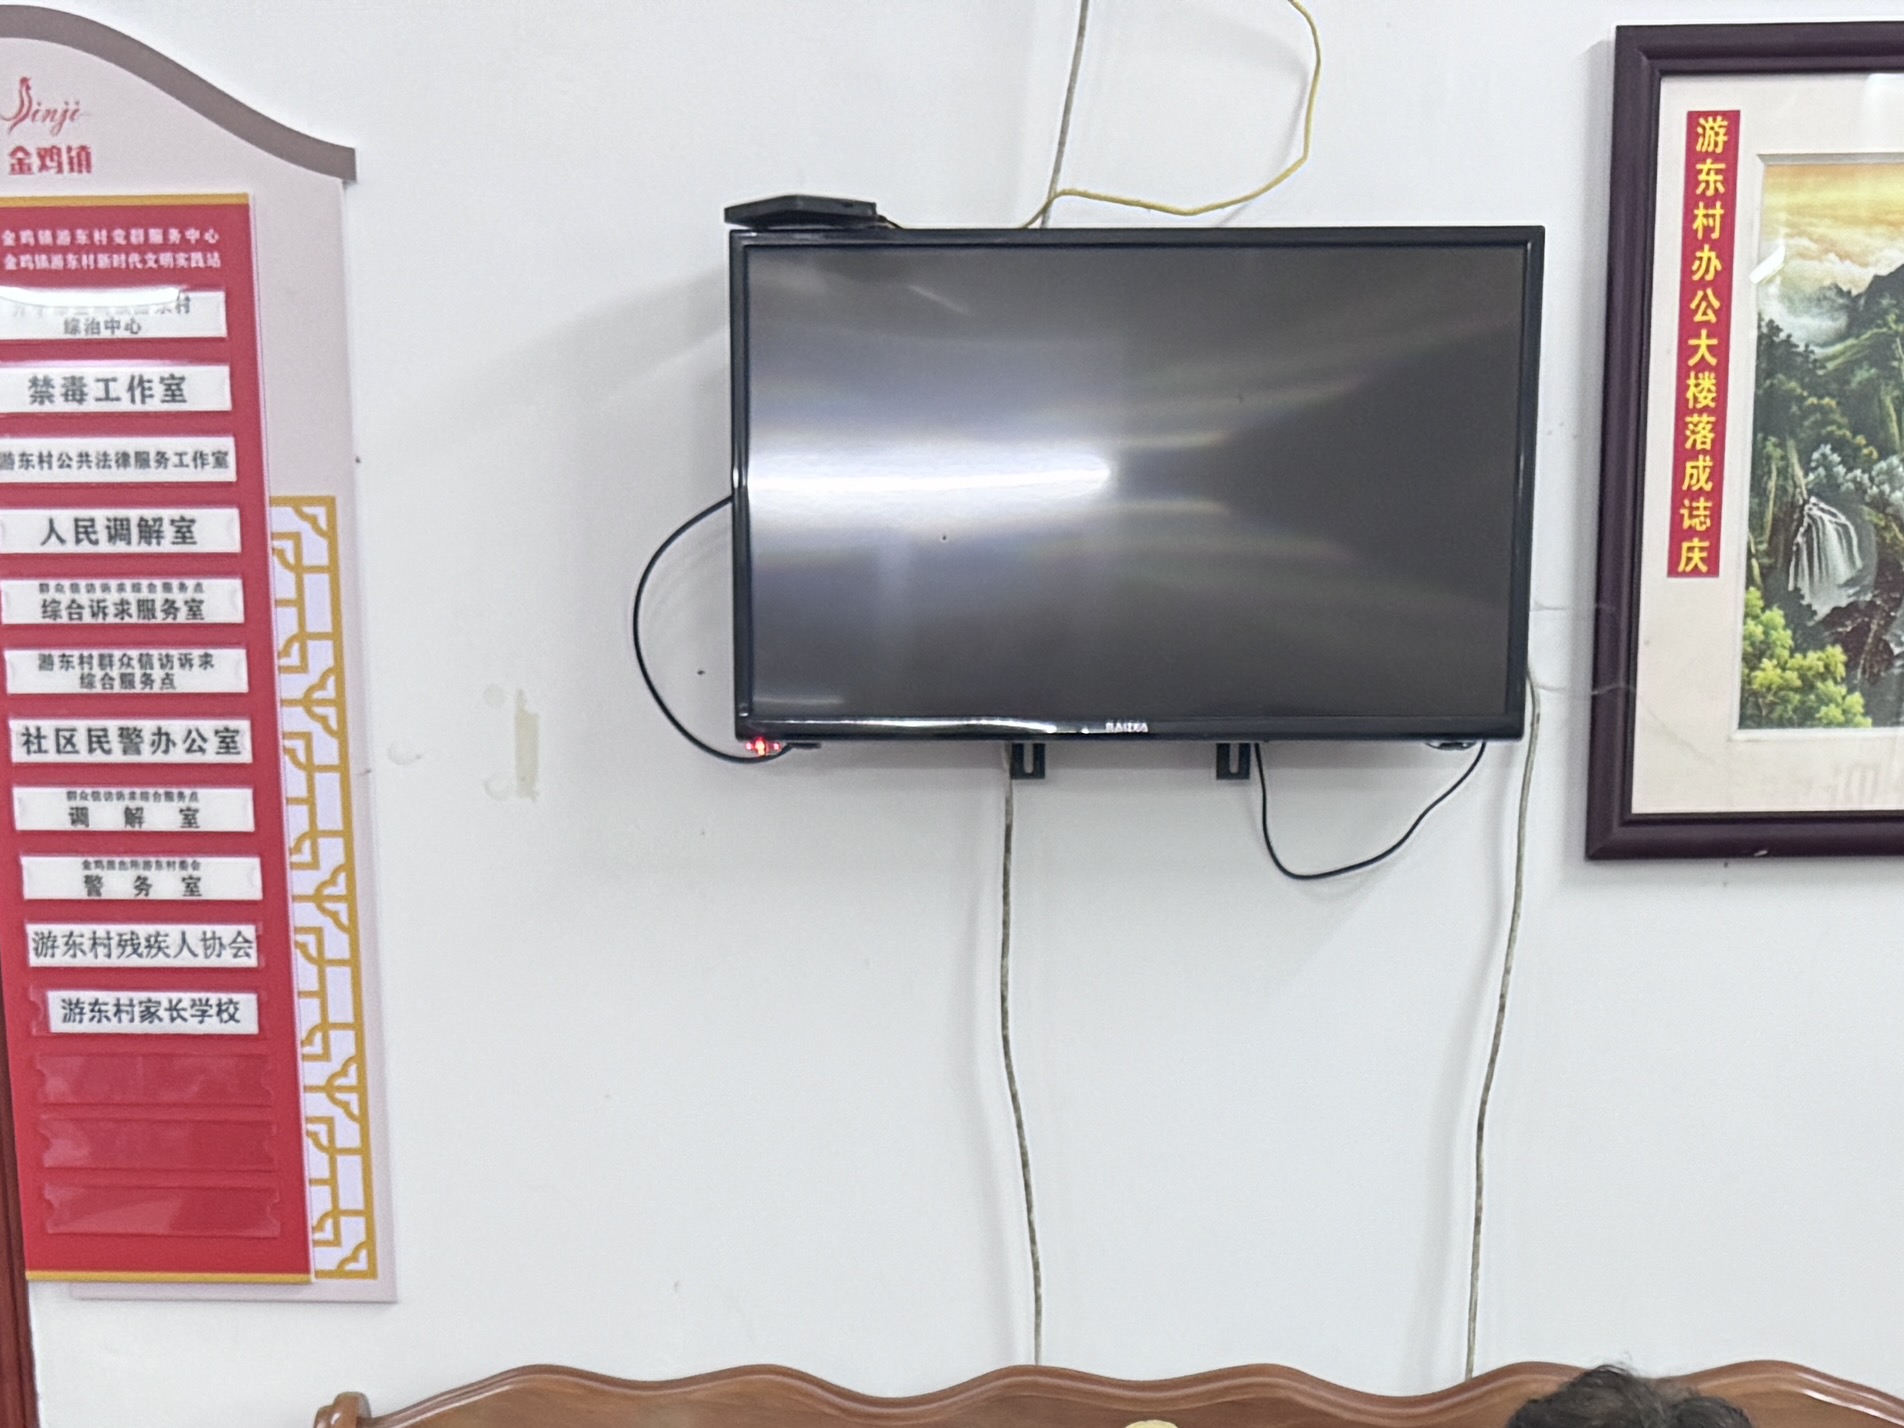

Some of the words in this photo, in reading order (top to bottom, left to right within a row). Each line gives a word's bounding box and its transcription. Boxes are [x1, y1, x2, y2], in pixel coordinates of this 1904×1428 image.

[7, 144, 93, 176] 金鸡镇
[27, 373, 188, 406] 禁毒工作室
[40, 515, 198, 547] 人民调解室
[41, 597, 206, 622] 综合诉求服务室
[38, 652, 215, 671] 游东村群众信访诉求
[79, 672, 177, 691] 综合服务点
[21, 725, 243, 757] 社区民警办公室
[68, 806, 201, 829] 调解室
[83, 874, 203, 898] 警务室
[31, 929, 255, 960] 游东村残疾人协会
[60, 997, 242, 1025] 游东村家长学校
